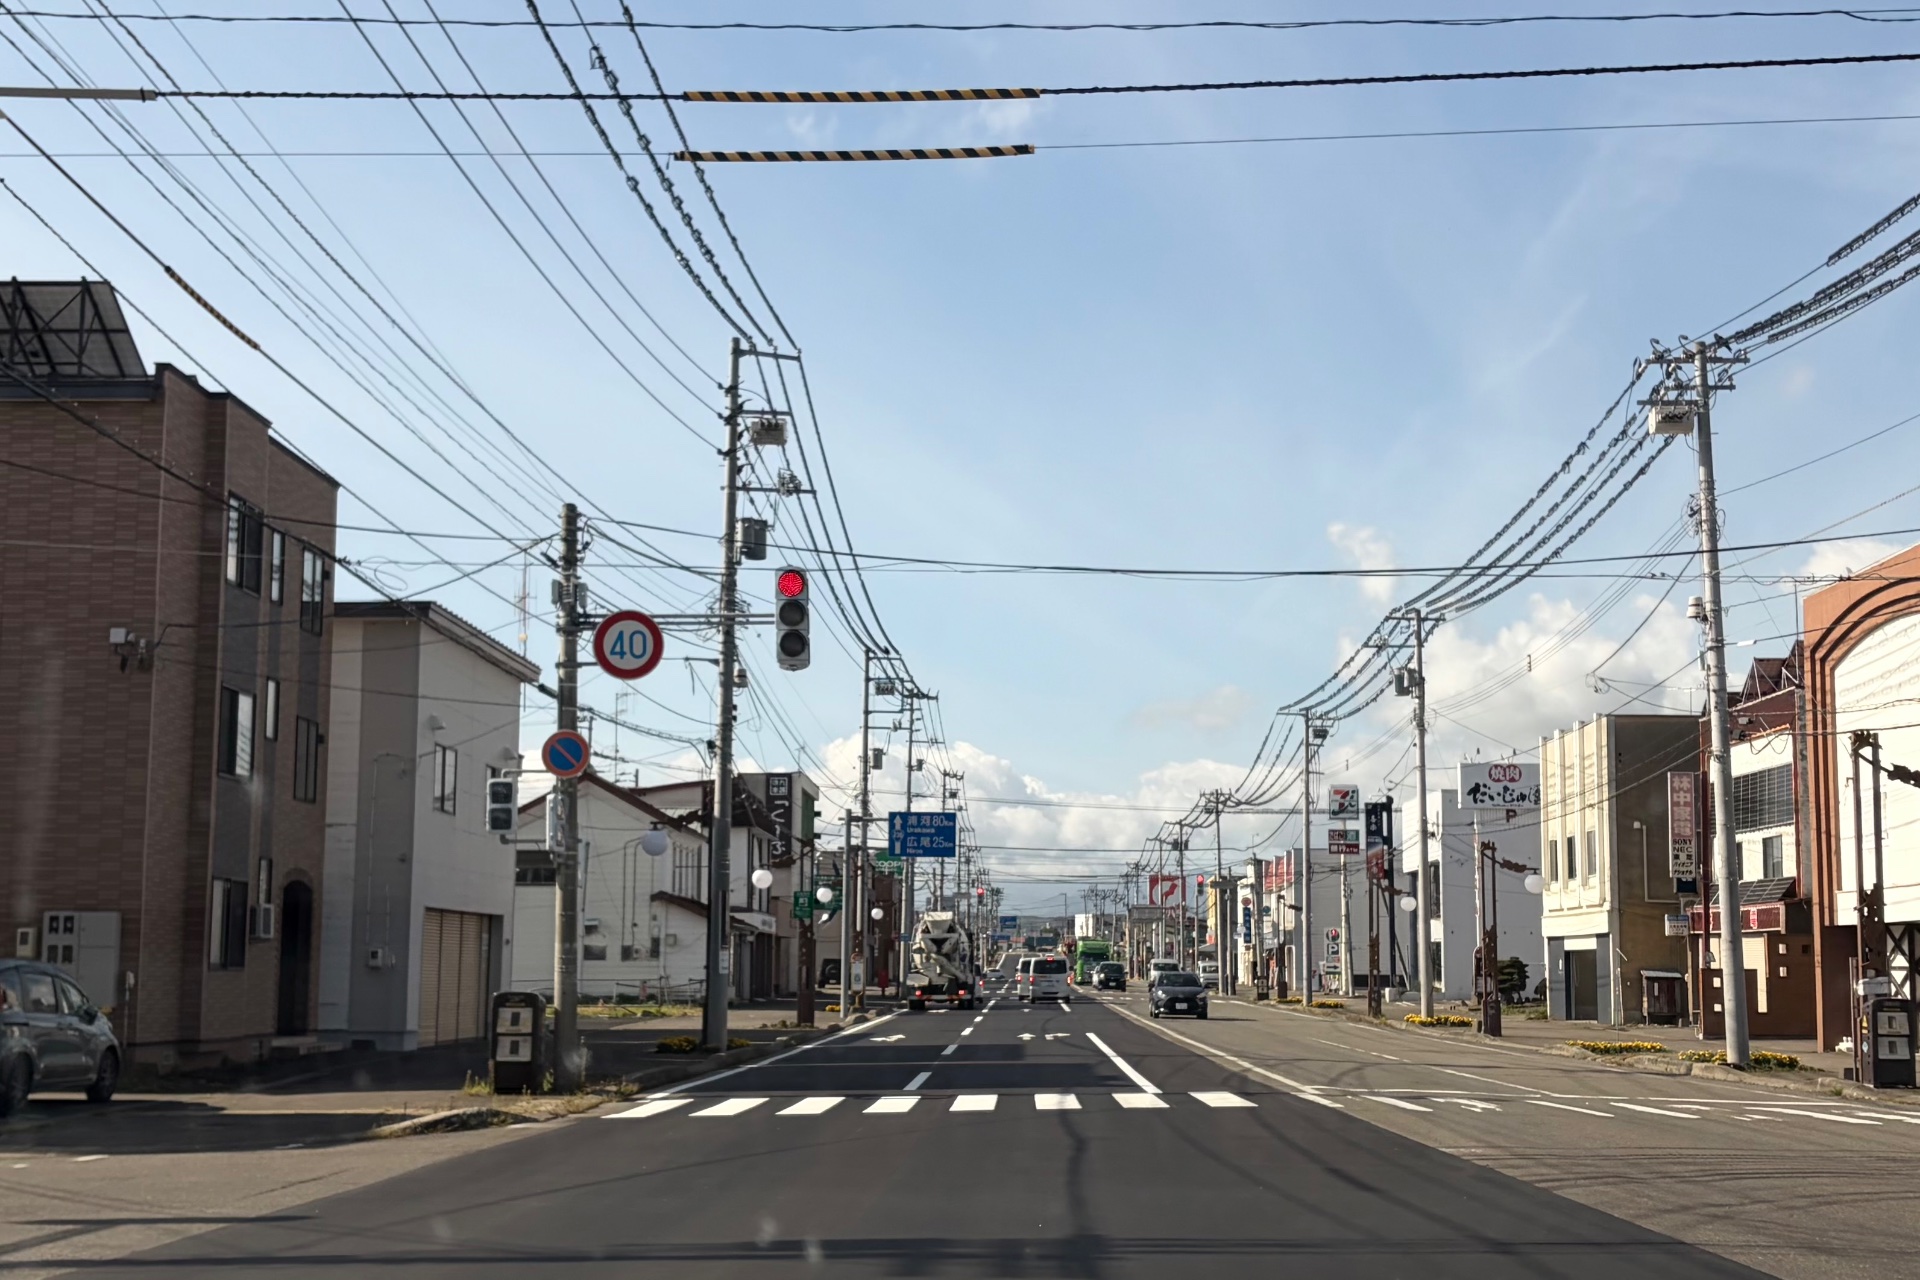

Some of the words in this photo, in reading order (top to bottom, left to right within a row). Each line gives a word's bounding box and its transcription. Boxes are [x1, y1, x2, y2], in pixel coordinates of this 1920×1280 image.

[609, 629, 647, 660] 40
[1490, 766, 1520, 781] 焼肉
[1672, 775, 1692, 836] 林中家電
[907, 815, 931, 827] 浦河
[1506, 809, 1517, 823] P
[906, 837, 931, 848] 広尾
[1328, 944, 1338, 954] P
